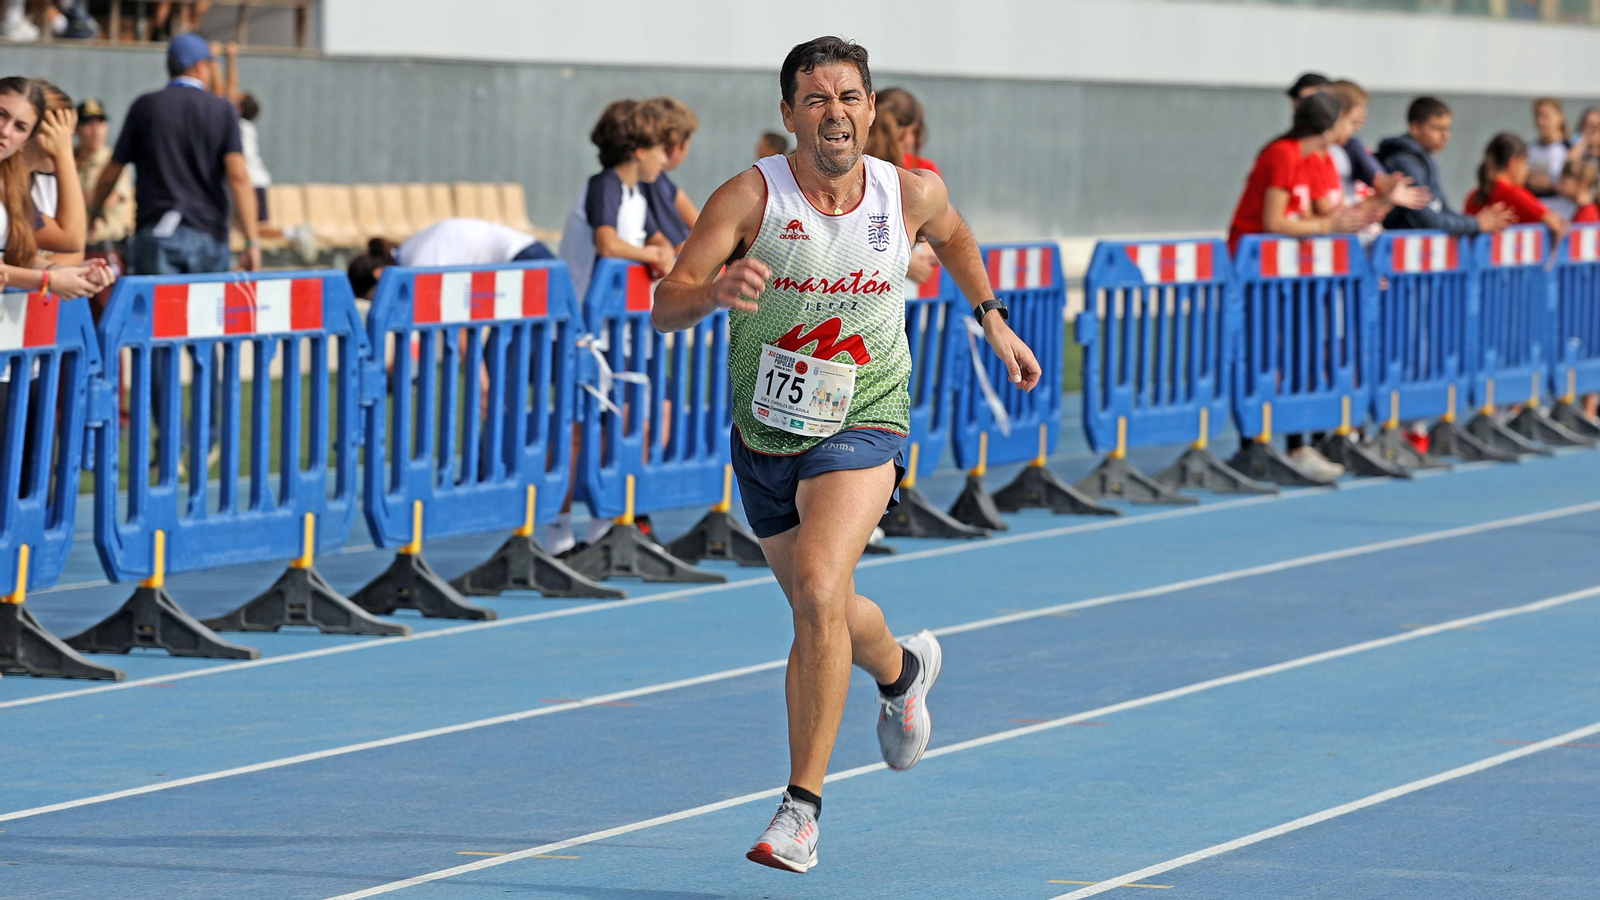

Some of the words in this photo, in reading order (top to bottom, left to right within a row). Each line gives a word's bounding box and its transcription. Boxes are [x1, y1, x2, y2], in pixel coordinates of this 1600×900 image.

[772, 268, 892, 295] maratón
[774, 357, 794, 368] POPULAR
[776, 352, 796, 363] CARRERA
[765, 368, 806, 404] 175
